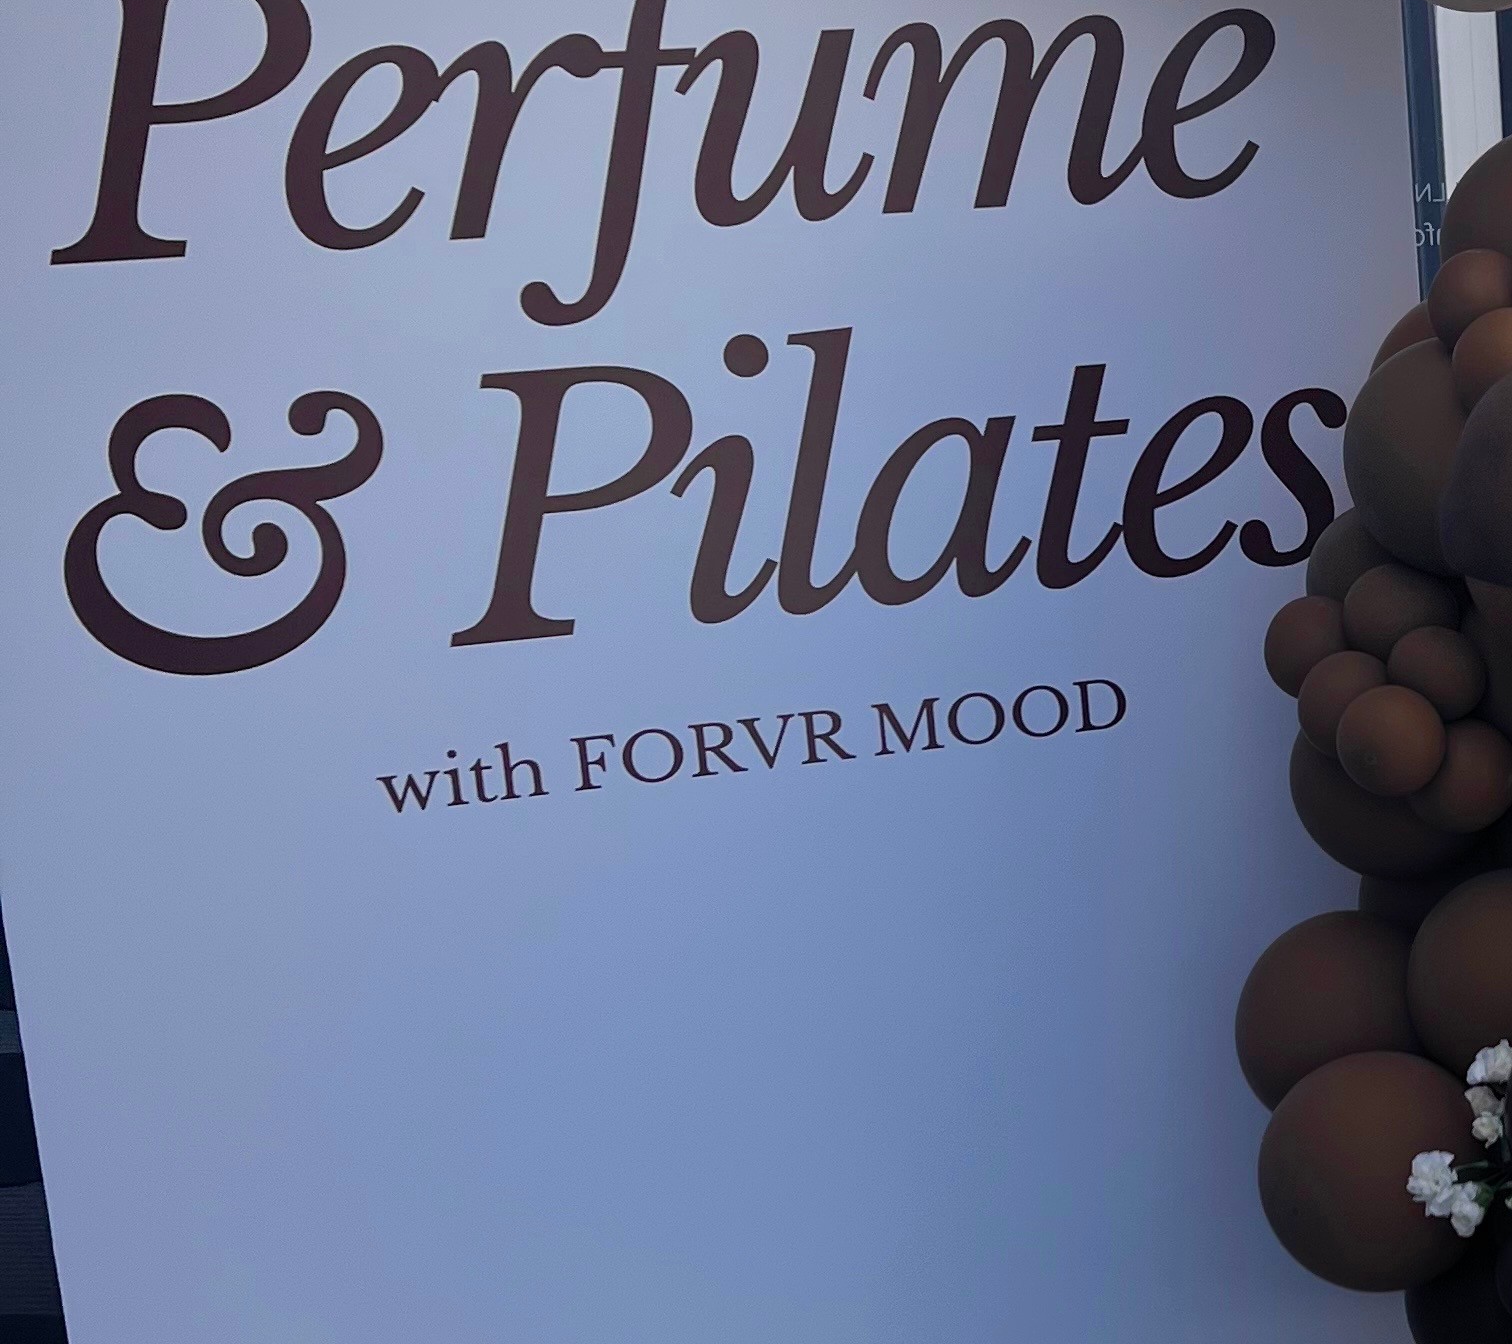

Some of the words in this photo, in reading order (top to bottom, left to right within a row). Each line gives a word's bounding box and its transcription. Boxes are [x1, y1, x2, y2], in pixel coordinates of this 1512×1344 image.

[62, 389, 385, 677] &
[449, 325, 1349, 648] Pilates
[377, 741, 549, 814] with
[572, 710, 856, 792] FORVR
[872, 679, 1128, 757] MOOD
